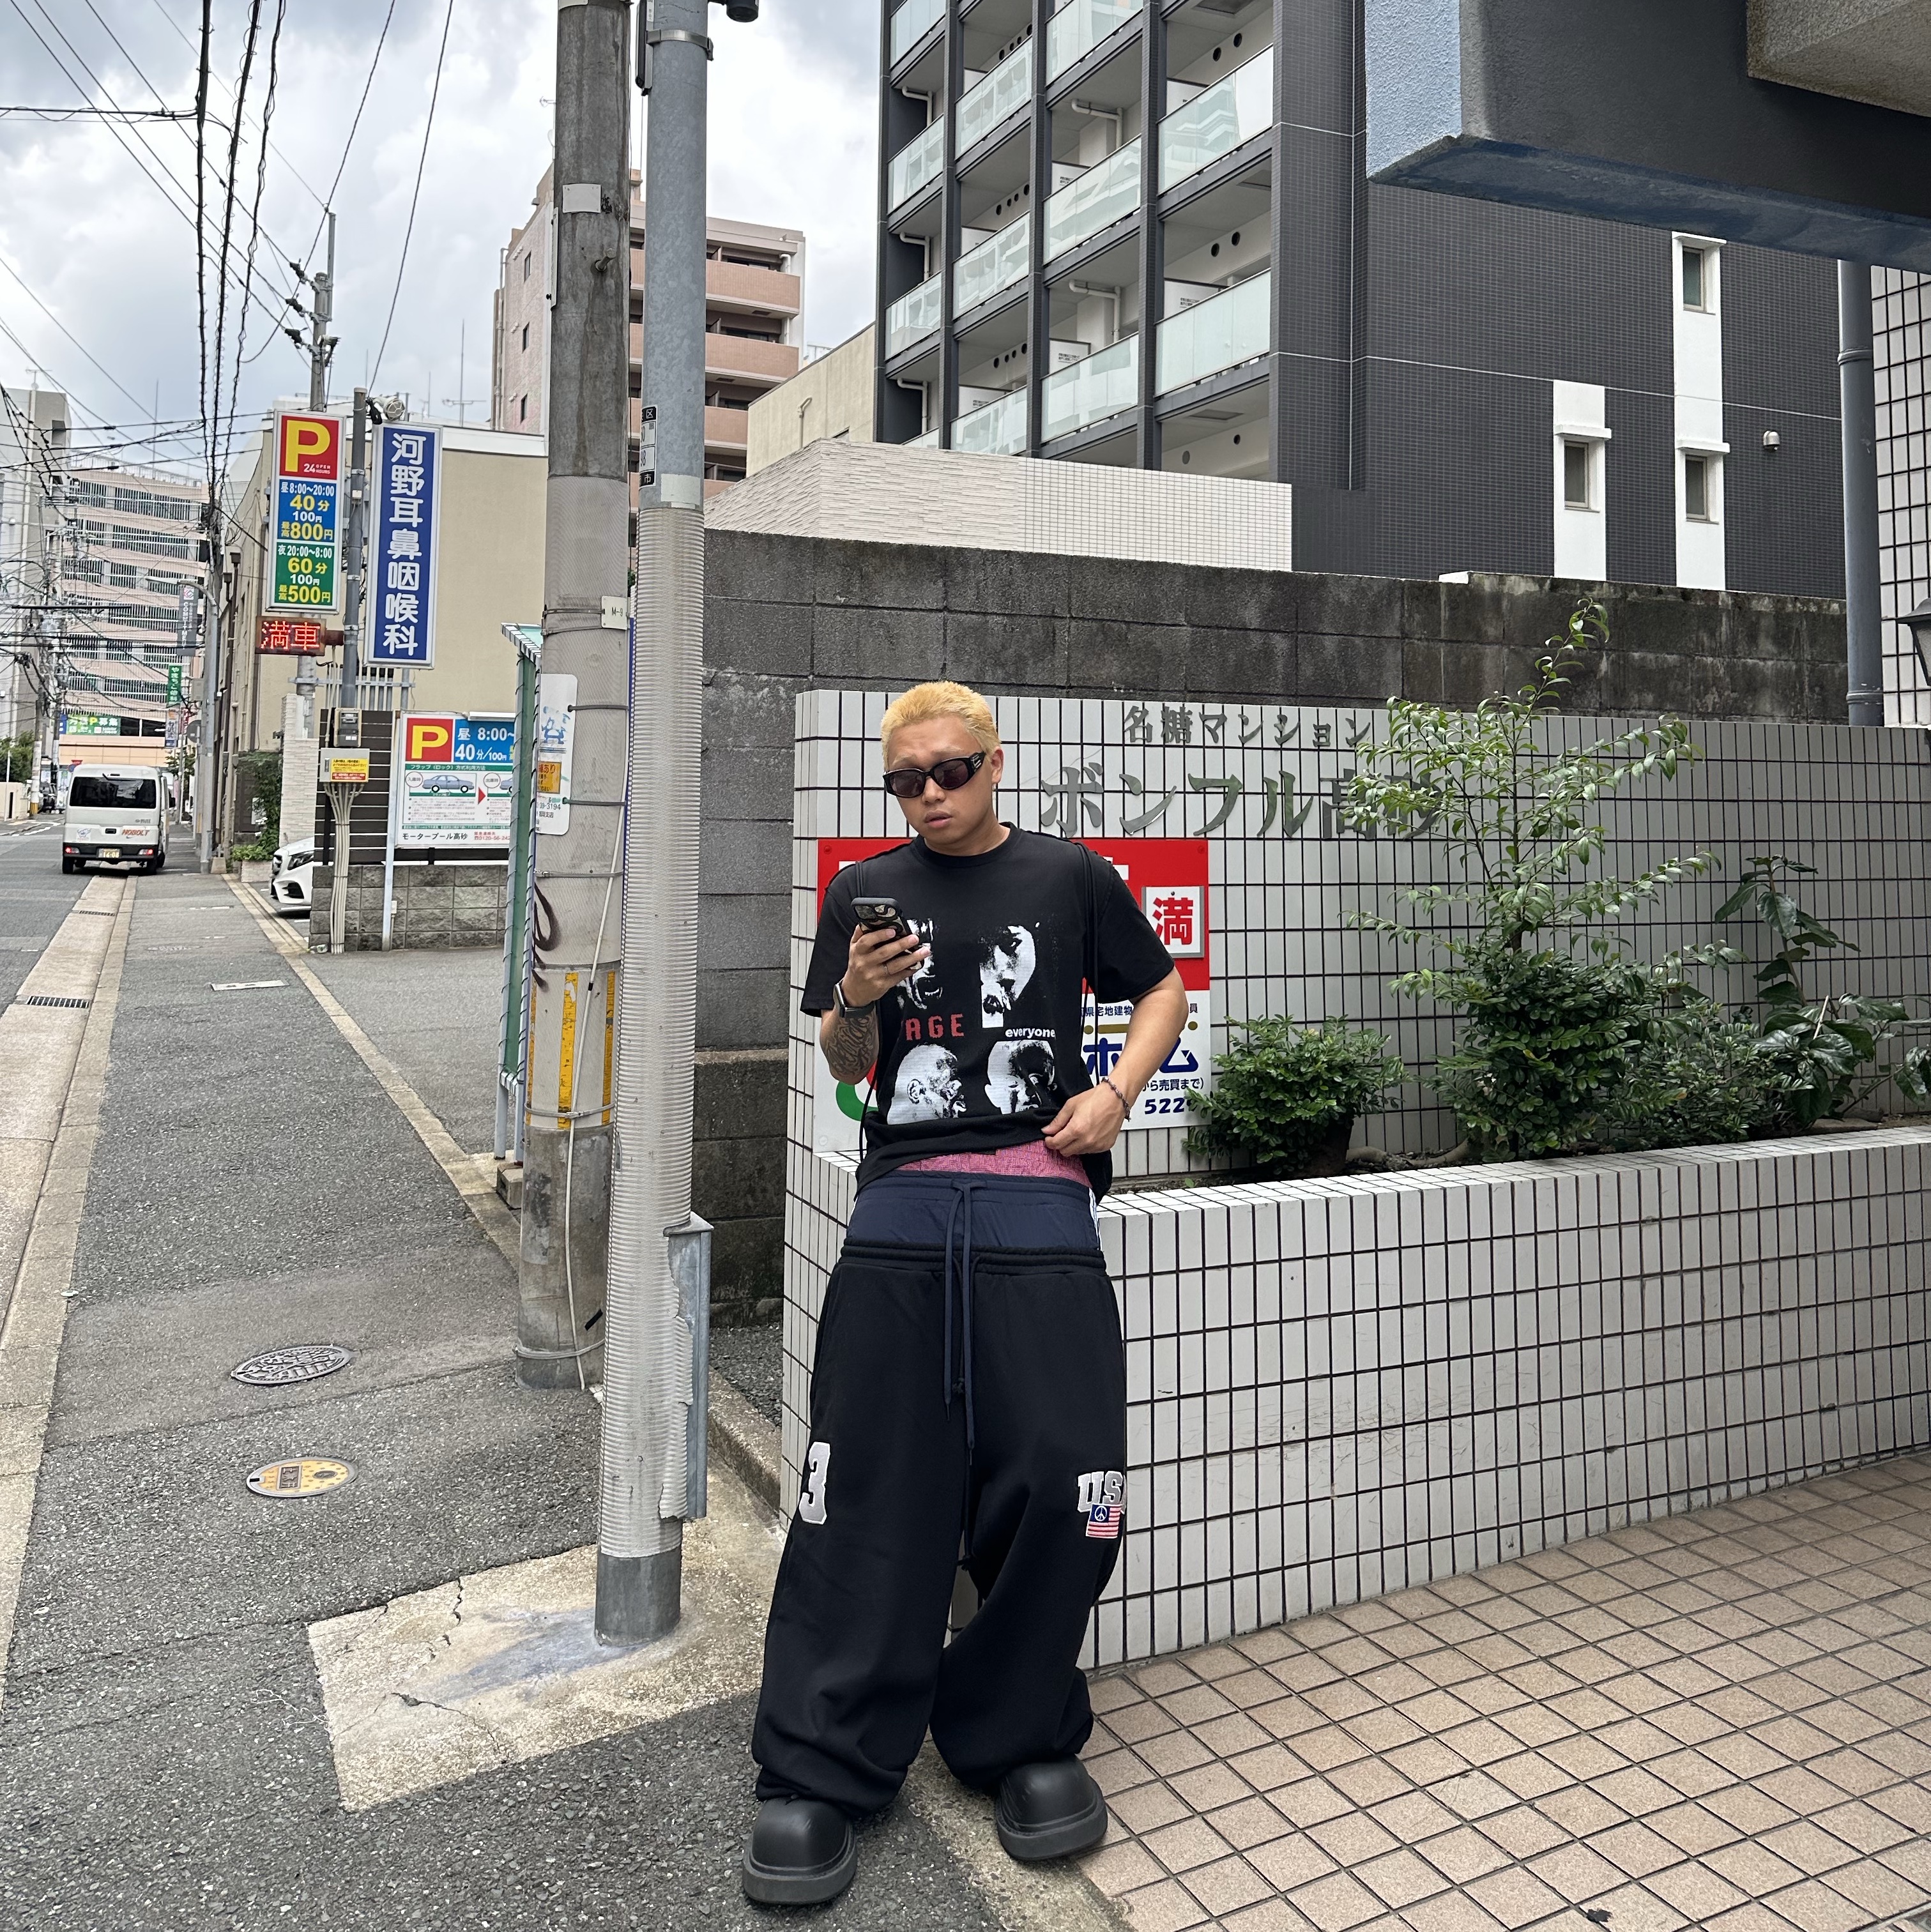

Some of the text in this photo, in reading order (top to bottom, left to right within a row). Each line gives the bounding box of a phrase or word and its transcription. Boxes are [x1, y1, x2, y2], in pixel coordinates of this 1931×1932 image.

[284, 420, 331, 473] P
[303, 463, 316, 473] 24
[293, 511, 323, 523] 100円
[383, 432, 427, 657] 河野耳鼻咽喉科
[290, 574, 320, 586] 100円
[261, 620, 321, 651] 満車
[1124, 704, 1371, 747] 名糖マンション
[411, 725, 449, 759] P
[402, 832, 468, 840] モータープール高砂
[1153, 897, 1193, 945] 満
[902, 1014, 965, 1040] AGE
[1005, 1028, 1056, 1040] everyone
[1145, 1097, 1192, 1115] 522
[798, 1441, 831, 1525] 3
[1078, 1471, 1126, 1514] US
